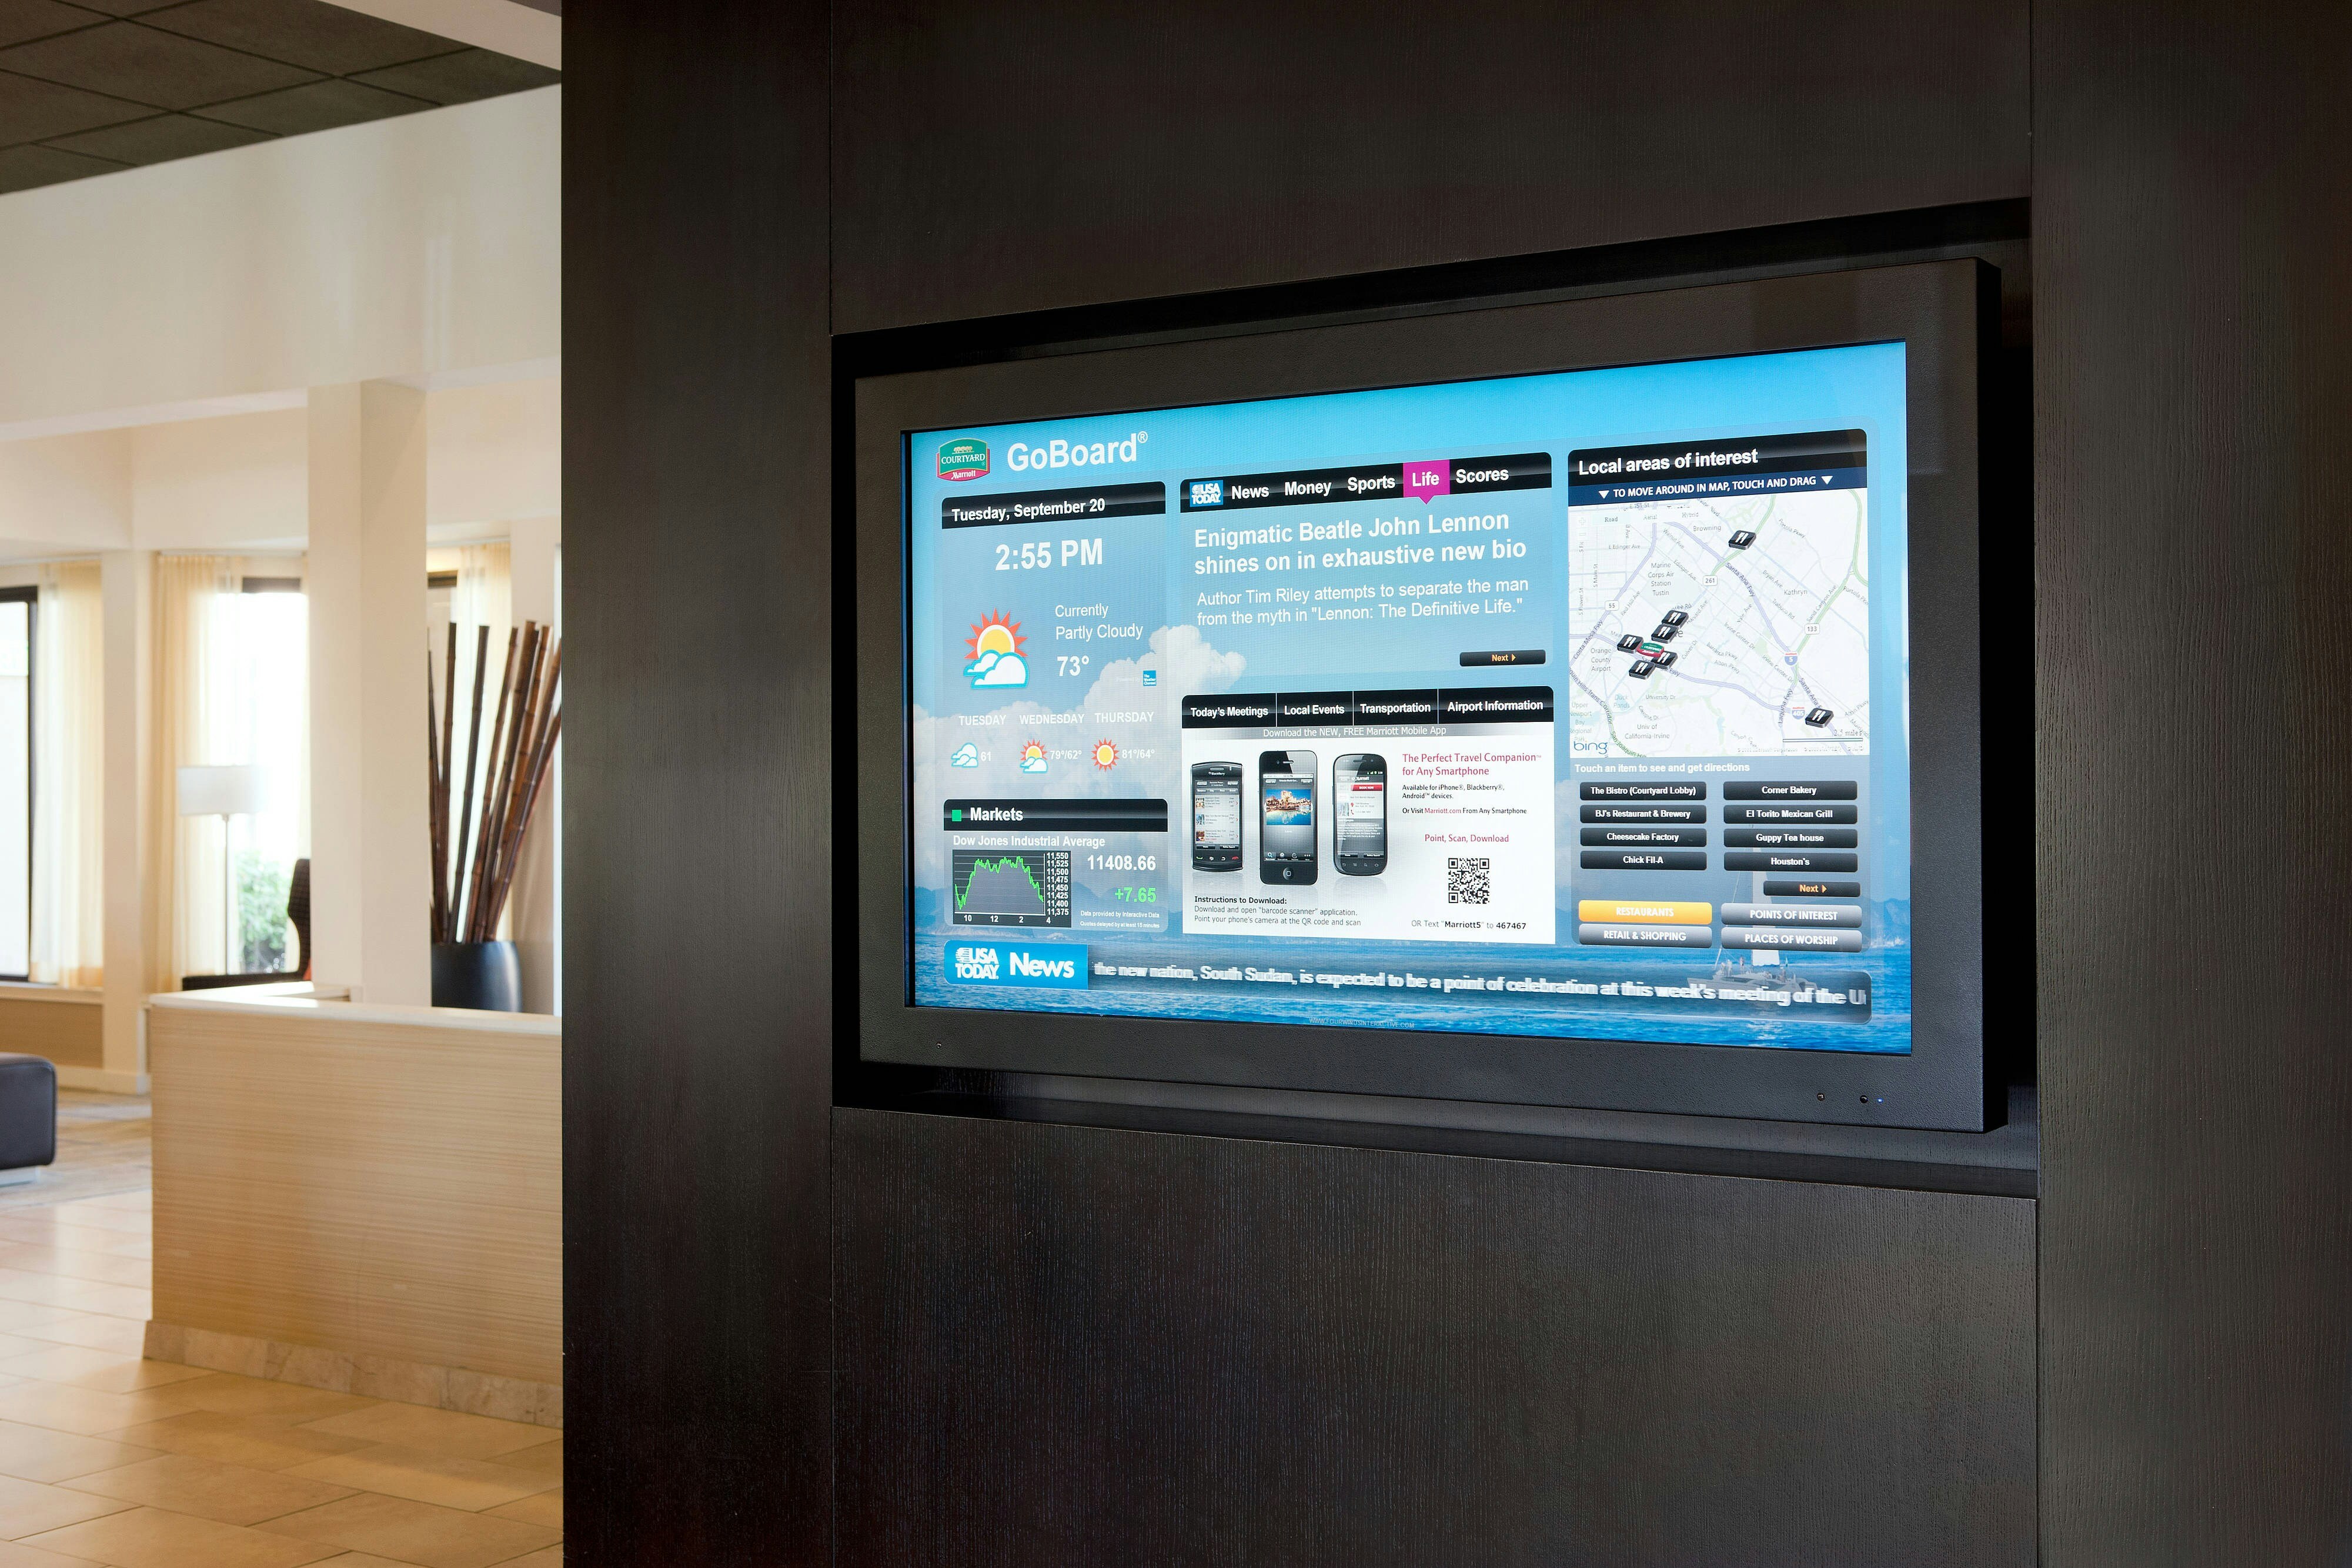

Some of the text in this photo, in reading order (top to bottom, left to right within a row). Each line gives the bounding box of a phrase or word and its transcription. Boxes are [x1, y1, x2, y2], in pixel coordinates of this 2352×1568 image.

[941, 453, 985, 464] COURTYARD
[1579, 448, 1758, 476] Local areas of interest
[951, 470, 975, 480] Marriott
[1232, 469, 1509, 499] News Money Sports Life Scores
[1613, 476, 1816, 497] TO MOVE AROUND IN MAP, TOUCH AND DRAG
[952, 498, 1105, 522] Tuesday, September 20
[1195, 513, 1509, 550] Enigmatic Beatle John Lennon
[995, 539, 1102, 570] 2:55 PM
[1195, 539, 1526, 574] shines on in exhaustive new bio
[1197, 579, 1528, 606] Author Tim Riley attempts to separate the man
[1055, 603, 1108, 618] Currently
[1197, 597, 1522, 626] from the myth in "Lennon: The Definitive Life."
[1055, 623, 1143, 642] Partly Cloudy
[1191, 706, 1268, 719] Today's Meetings
[1285, 704, 1345, 715] Local Events
[1360, 703, 1431, 715] Transportation
[1448, 701, 1543, 714] Airport Information
[959, 712, 1154, 726] TUESDAY WEDNESDAY THURSDAY
[1264, 728, 1301, 737] Download
[1319, 728, 1341, 737] NEW,
[1367, 727, 1398, 735] Marriott
[1402, 726, 1427, 734] Mobile
[1430, 727, 1446, 735] App
[1574, 741, 1608, 754] bing
[1402, 754, 1419, 763] The
[1421, 754, 1452, 762] Perfect
[1455, 753, 1482, 762] Travel
[1402, 767, 1489, 777] for Any Smartphone
[1630, 787, 1668, 795] (Courtyard
[1670, 787, 1696, 795] Lobby)
[1790, 786, 1816, 795] Bakery
[970, 807, 1024, 821] Markets
[1661, 810, 1690, 819] Brewery
[953, 835, 1105, 849] Dow Jones Industrial Average
[1425, 834, 1446, 842] Point,
[1448, 835, 1468, 843] Scan,
[1652, 833, 1679, 842] Factory
[1756, 833, 1782, 843] Guppy
[1800, 834, 1824, 842] house
[1087, 855, 1155, 871] 11408.66
[1771, 857, 1810, 865] Houston's
[1115, 887, 1156, 902] +7.65
[1799, 885, 1819, 893] Next
[1047, 908, 1068, 917] 11,375
[1616, 907, 1674, 917] RESTAURANTS
[1750, 910, 1838, 920] POINTS OF INTEREST
[1745, 934, 1838, 945] PLACES OF WORSHIP
[969, 948, 998, 964] USA
[1010, 952, 1075, 978] News
